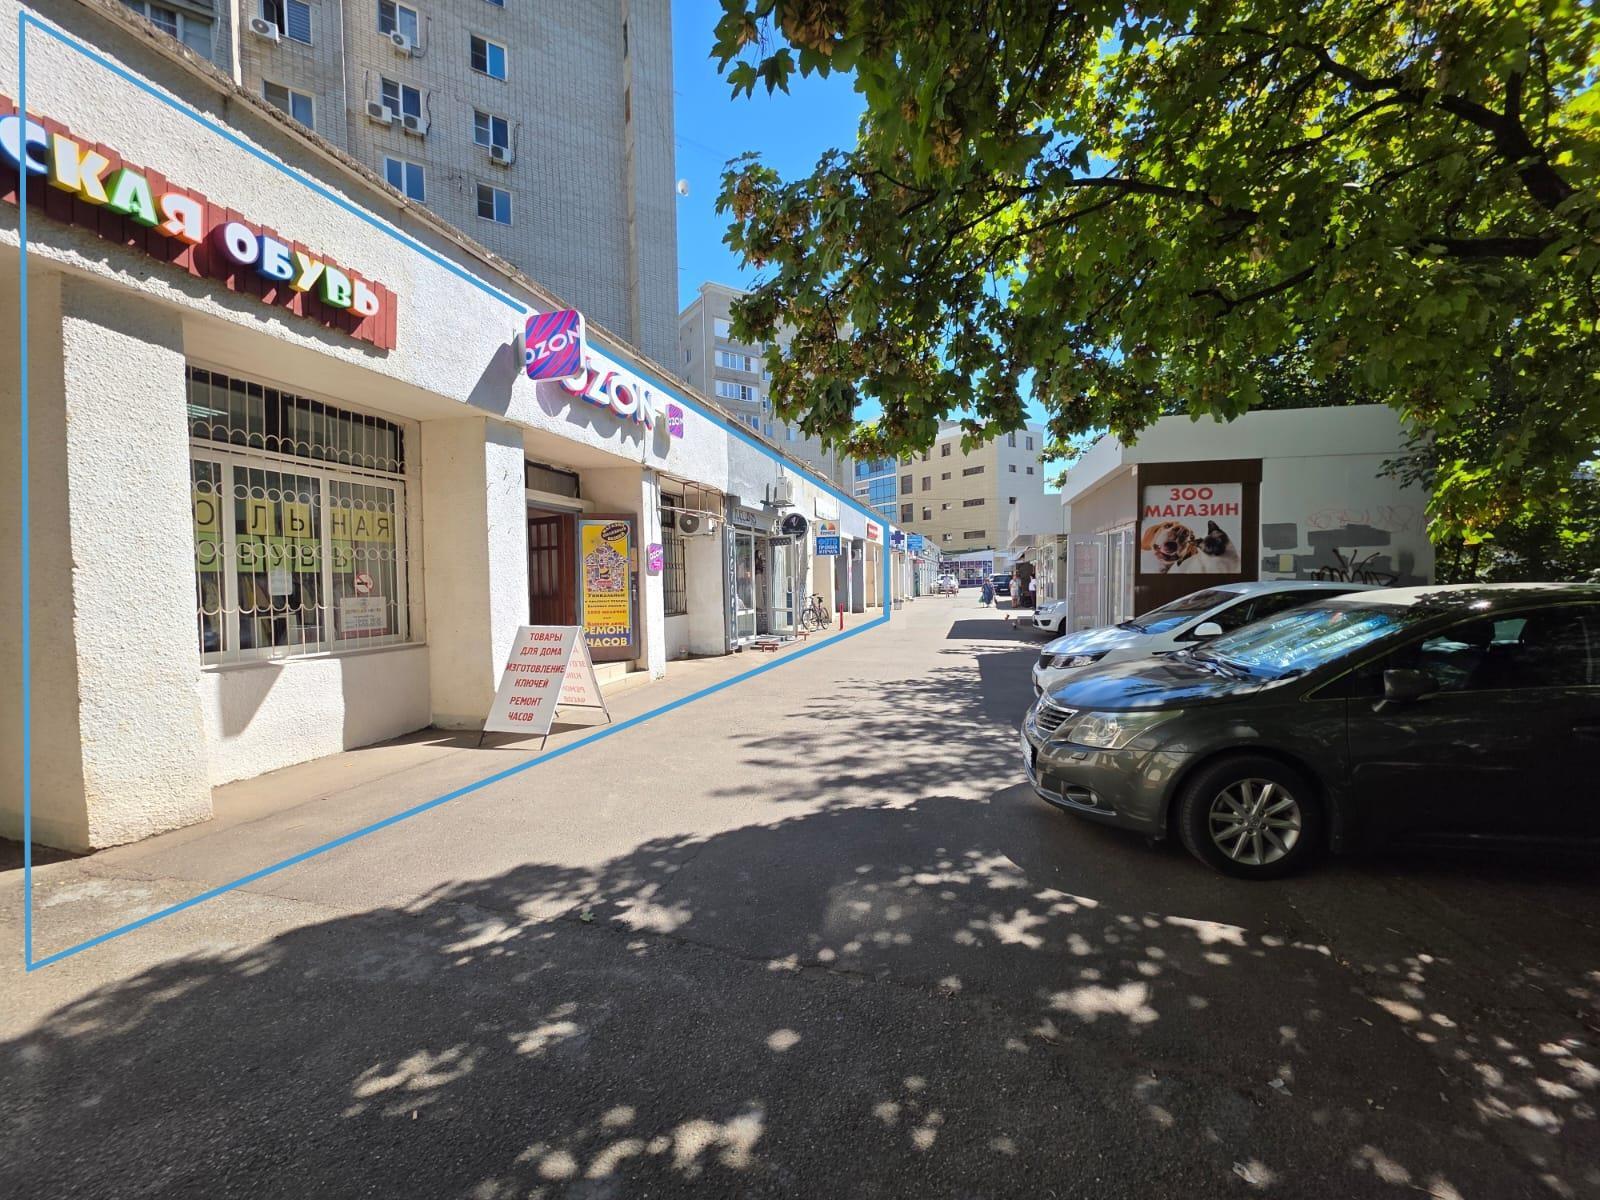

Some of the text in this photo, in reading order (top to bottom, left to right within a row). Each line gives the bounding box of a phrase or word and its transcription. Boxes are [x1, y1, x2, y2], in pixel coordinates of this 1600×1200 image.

[0, 115, 380, 318] СКАЯ ОБУВЬ
[1170, 487, 1213, 501] ЗОО
[1144, 502, 1239, 518] МАГАЗИН
[197, 540, 348, 569] ОБУВЬ
[583, 626, 630, 635] РЕМОНТ
[530, 633, 562, 641] ТОВАРЫ
[586, 637, 628, 647] ЧАСОВ
[521, 647, 561, 656] ДЛЯ ДОМА
[506, 663, 565, 673] ИЗГОТОВЛЕНИЕ
[514, 678, 549, 688] КЛЮЧЕЙ
[509, 696, 542, 706] РЕМОНТ
[508, 712, 534, 721] ЧАСОВ
